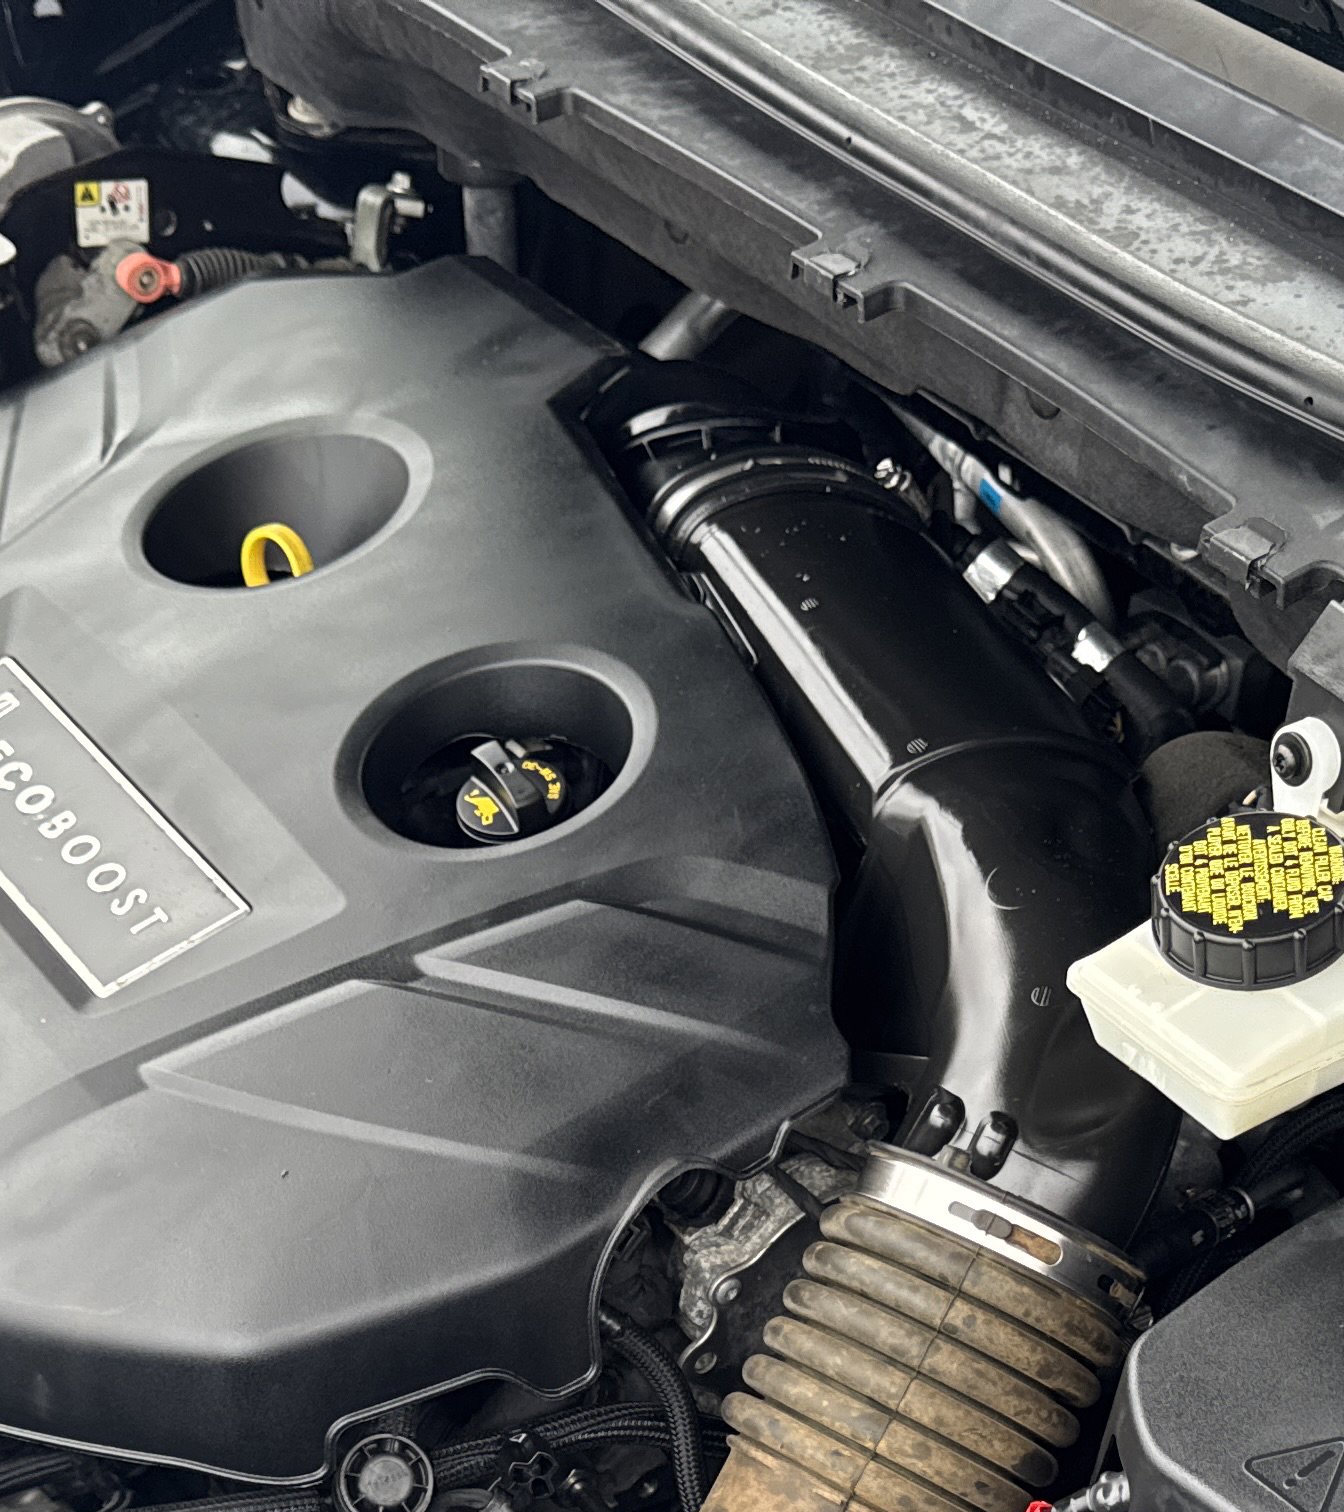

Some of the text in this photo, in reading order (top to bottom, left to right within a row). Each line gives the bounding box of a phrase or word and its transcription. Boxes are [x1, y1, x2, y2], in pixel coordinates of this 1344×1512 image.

[1207, 828, 1223, 856] PLOYER
[1221, 818, 1236, 841] AVANT
[1193, 840, 1208, 855] DOT
[1223, 844, 1238, 855] DE
[1268, 835, 1284, 864] SEALED
[1284, 841, 1298, 856] DOT
[1224, 858, 1239, 868] LE
[1236, 825, 1257, 920] NETTOYER LE BOUCHON
[1252, 839, 1270, 903] AVERTISSEMENT:
[1296, 820, 1318, 914] BEFORE REMOVING. USE
[1312, 828, 1333, 901] CLEAN FILLER CAP
[1329, 845, 1344, 884] WARNING:
[1181, 867, 1196, 912] CONTENANT
[1195, 868, 1211, 913] PROVENANT
[1270, 867, 1288, 913] CONTAINER.
[1286, 869, 1301, 891] FLUID
[1288, 895, 1304, 918] FROM
